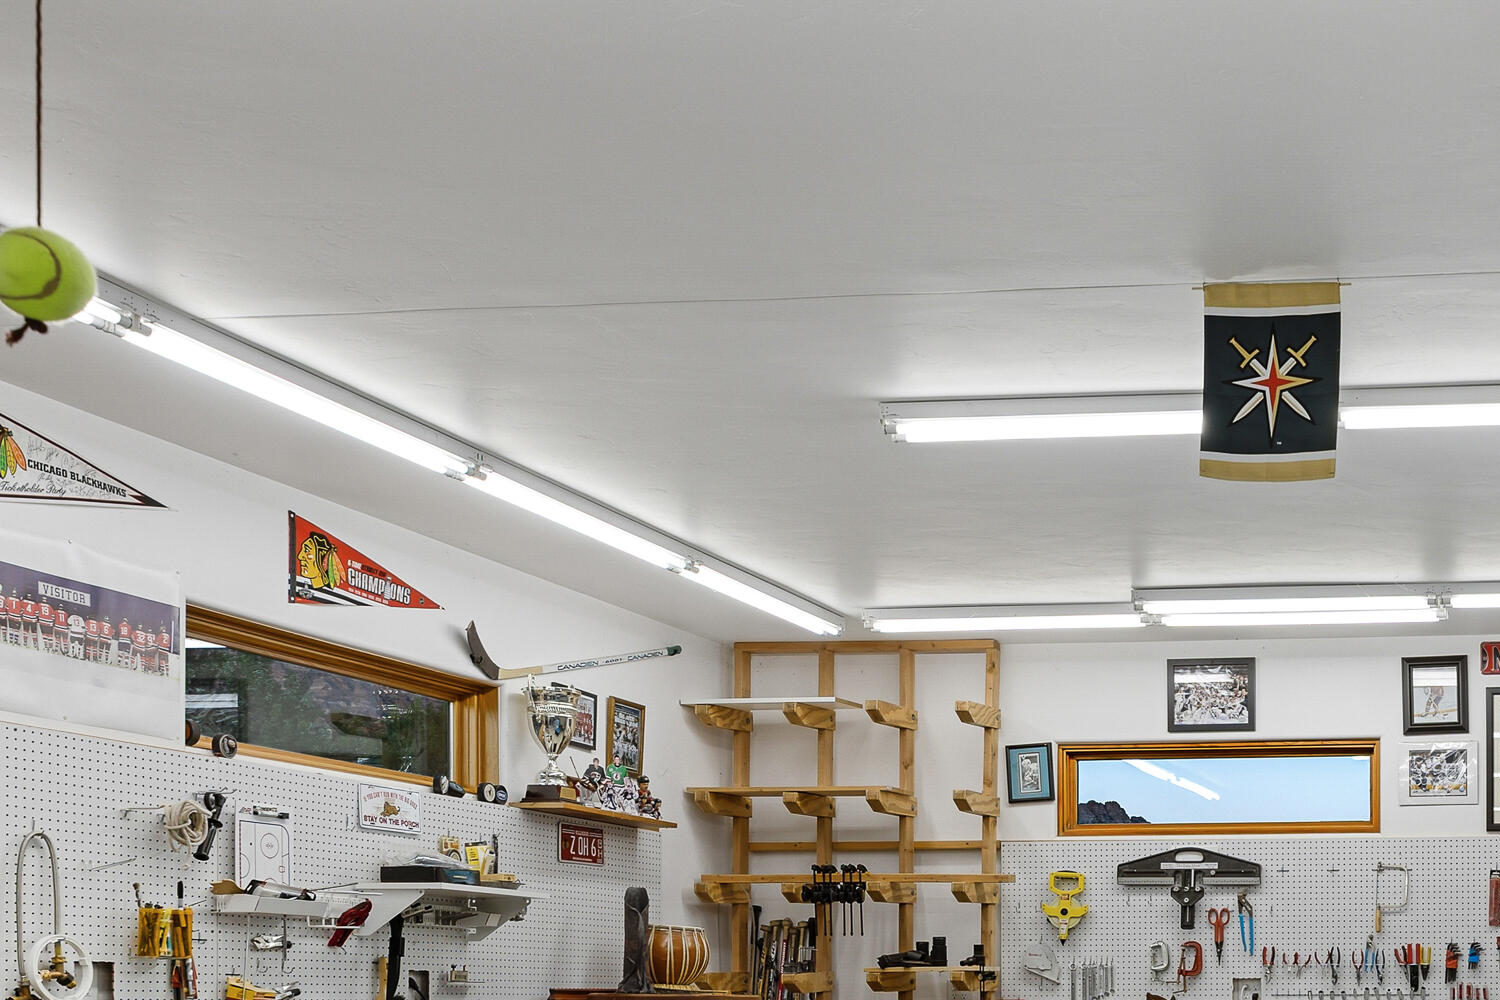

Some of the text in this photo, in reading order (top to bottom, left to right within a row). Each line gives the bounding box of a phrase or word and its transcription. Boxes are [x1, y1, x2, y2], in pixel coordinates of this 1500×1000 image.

[27, 459, 127, 498] CHICAGO BLACKHAWKS
[46, 482, 66, 496] Party
[42, 583, 86, 604] VISITOR
[401, 820, 420, 828] PORCH
